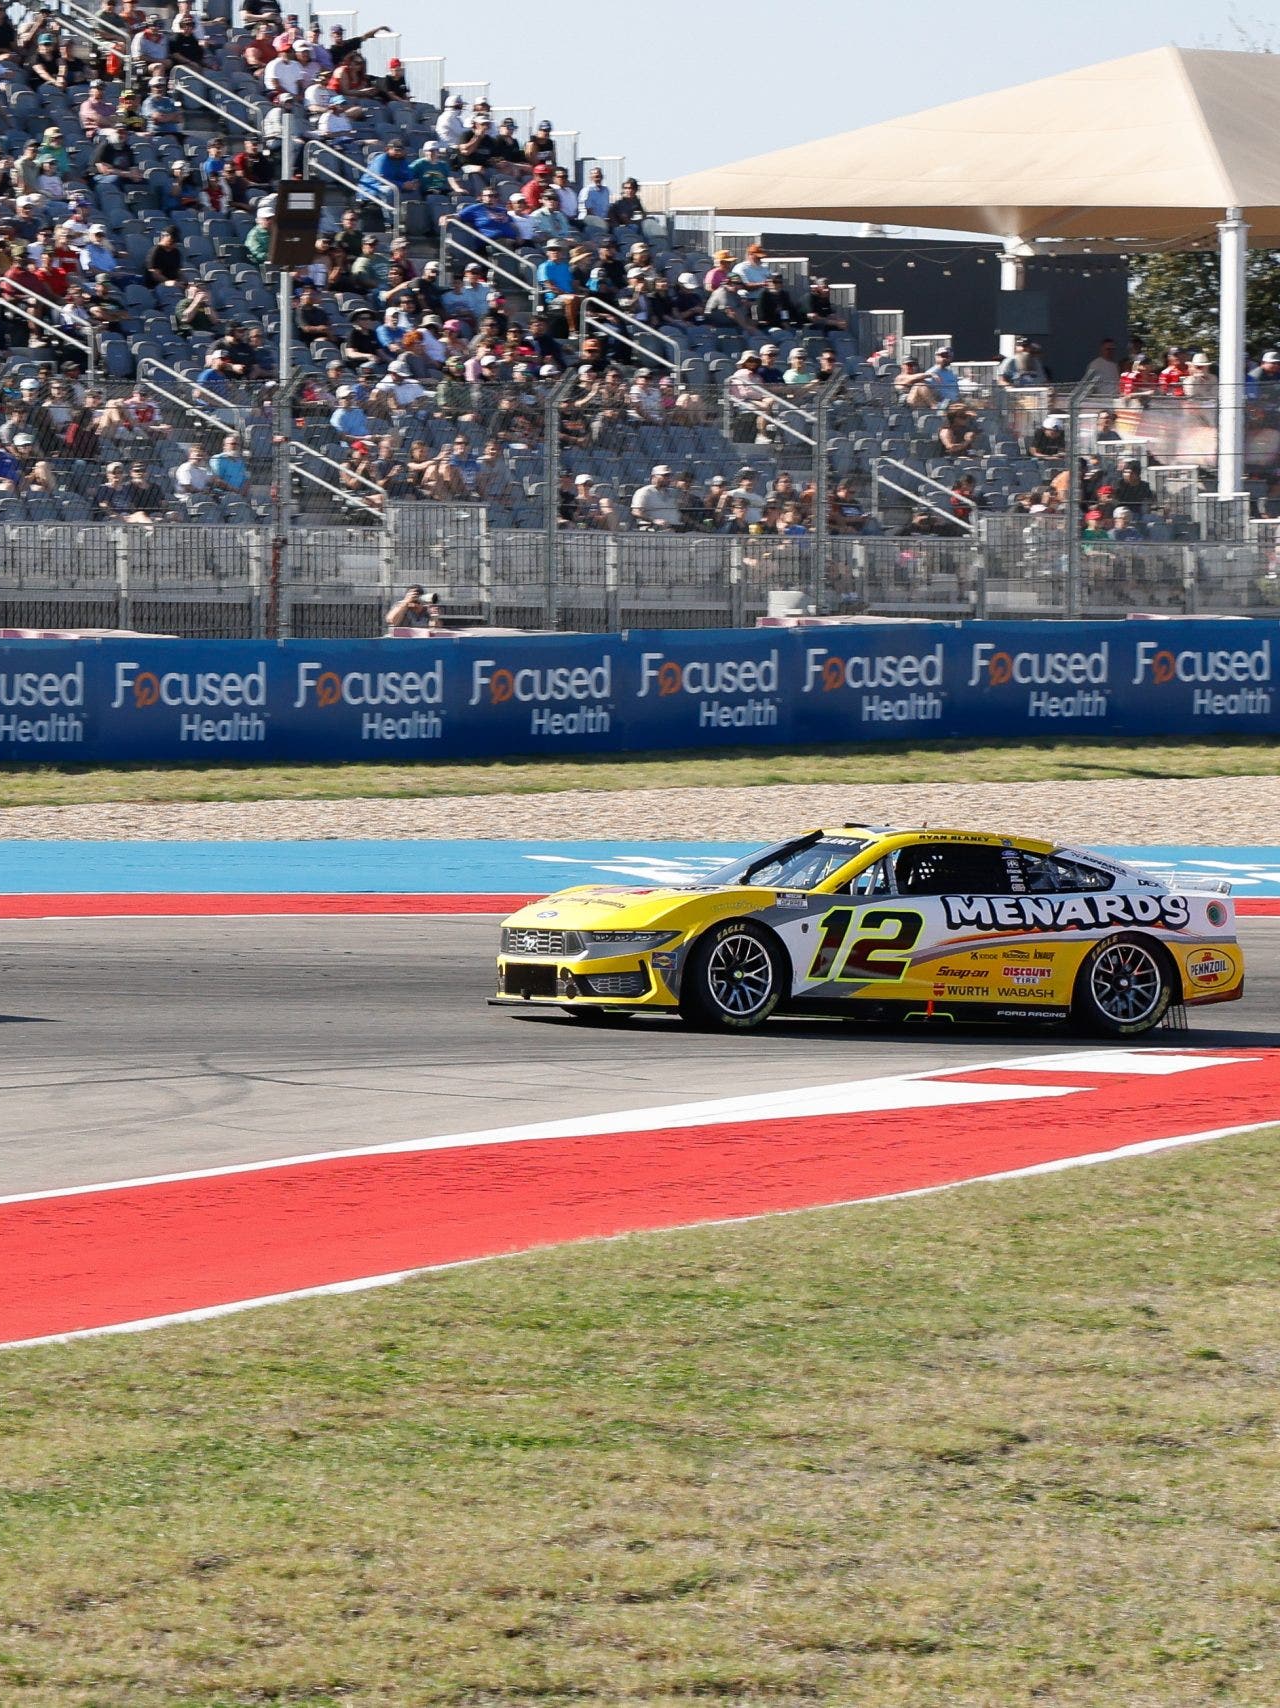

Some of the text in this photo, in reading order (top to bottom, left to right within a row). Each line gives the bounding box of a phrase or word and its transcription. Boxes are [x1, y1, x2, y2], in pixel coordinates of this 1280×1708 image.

[637, 649, 778, 698] Focused
[804, 643, 943, 692] Focused
[970, 642, 1108, 687] Focused
[1132, 640, 1270, 685] Focused
[111, 661, 265, 708] Focused
[294, 660, 443, 708] Focused
[470, 656, 611, 705] Focused
[700, 699, 777, 727] Health
[862, 693, 941, 721] Health
[1029, 690, 1109, 717] Health
[1193, 687, 1271, 715] Health
[180, 713, 265, 742] Health
[362, 711, 442, 739] Health
[531, 706, 610, 735] Health
[940, 895, 1191, 931] MENARDS
[717, 923, 747, 942] EAGLE
[806, 905, 925, 983] 12
[936, 966, 990, 979] Snap-on
[1003, 967, 1052, 978] DISCOUNT
[1190, 960, 1228, 977] PENNZOIL
[998, 988, 1055, 998] WABASH
